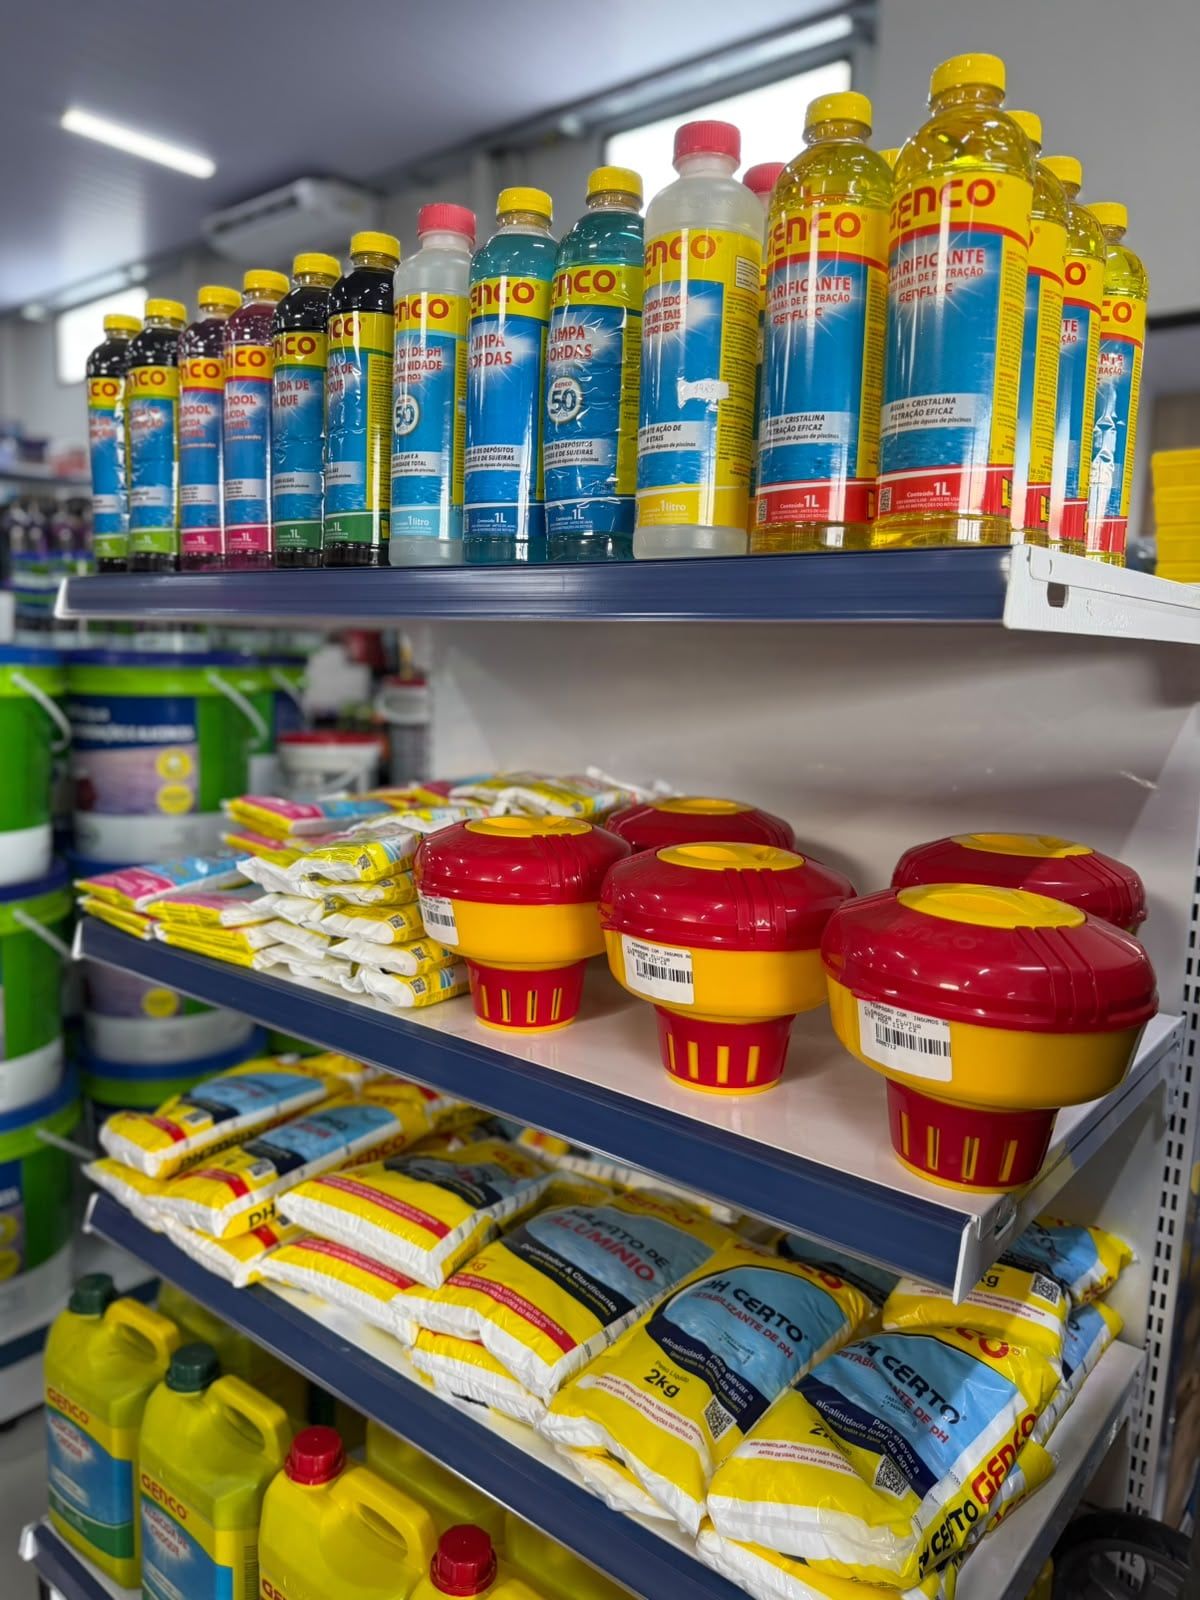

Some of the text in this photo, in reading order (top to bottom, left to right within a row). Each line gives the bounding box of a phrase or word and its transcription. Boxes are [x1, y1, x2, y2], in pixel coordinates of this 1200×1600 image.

[644, 234, 717, 277] ENCO
[931, 267, 984, 280] FTRAÇÃO
[551, 269, 616, 306] NCO
[471, 282, 535, 315] ENCO
[802, 293, 850, 305] FTRAÇÃO
[395, 298, 450, 330] NCO
[549, 344, 593, 362] ORDAS
[550, 388, 577, 415] 50
[912, 396, 957, 409] CRISTALINA
[785, 413, 825, 424] CRISTALINA
[925, 407, 954, 417] EFICAZ
[797, 423, 823, 432] EFICAZ
[933, 481, 951, 496] 1L
[804, 494, 820, 508] 1L
[494, 512, 507, 524] 1L
[572, 508, 585, 520] 1L
[290, 528, 301, 539] 1L
[334, 521, 342, 532] 1L
[242, 532, 253, 542] 1L
[551, 1216, 656, 1281] ALUMÍNIO
[647, 1249, 670, 1268] DE
[732, 1288, 804, 1342] CERTO
[761, 1328, 779, 1342] DE
[661, 1336, 706, 1363] alcalinidade
[718, 1378, 729, 1392] da
[728, 1388, 749, 1410] água
[643, 1368, 681, 1398] 2kg
[725, 1366, 749, 1395] elevar
[748, 1394, 754, 1402] a
[881, 1354, 960, 1425] CERTO
[913, 1406, 932, 1425] DE
[815, 1399, 867, 1433] alcalinidade
[866, 1426, 889, 1441] total
[886, 1440, 899, 1454] da
[896, 1453, 915, 1480] água
[872, 1417, 920, 1475] Para elevar a
[141, 1473, 188, 1521] GENCO
